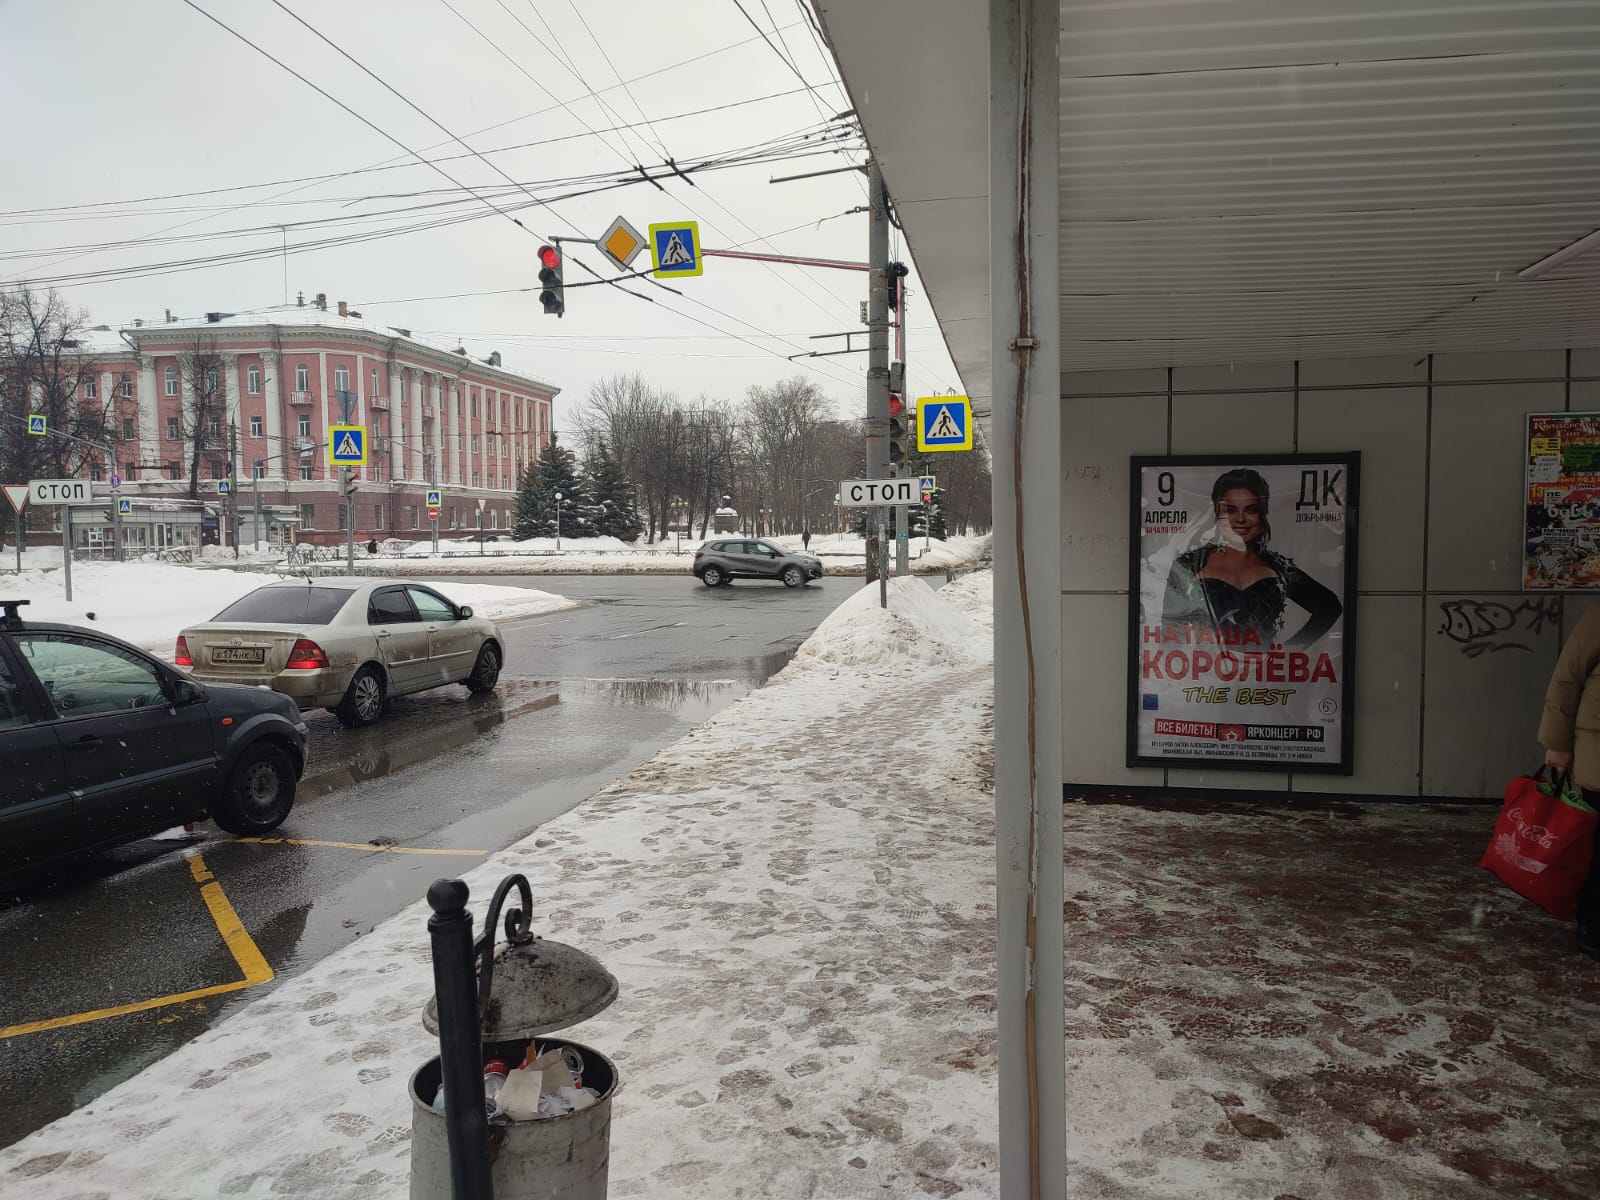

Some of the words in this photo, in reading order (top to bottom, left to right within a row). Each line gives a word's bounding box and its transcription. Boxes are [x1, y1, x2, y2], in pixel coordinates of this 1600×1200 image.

[37, 483, 85, 500] СТОП
[850, 483, 911, 501] СТОП
[1157, 471, 1175, 506] 9
[1295, 469, 1344, 511] ДК
[1144, 511, 1187, 524] АПРЕЛЯ
[1143, 625, 1261, 645] НАТАША
[1142, 643, 1337, 684] КОРОЛЁВА
[1182, 686, 1231, 704] THE
[1236, 687, 1297, 706] BEST
[1157, 720, 1174, 732] ВСЕ
[1175, 721, 1213, 737] БИЛЕТЫ
[1248, 724, 1299, 739] ЯРКОНЦЕРТ
[1306, 725, 1321, 739] РФ
